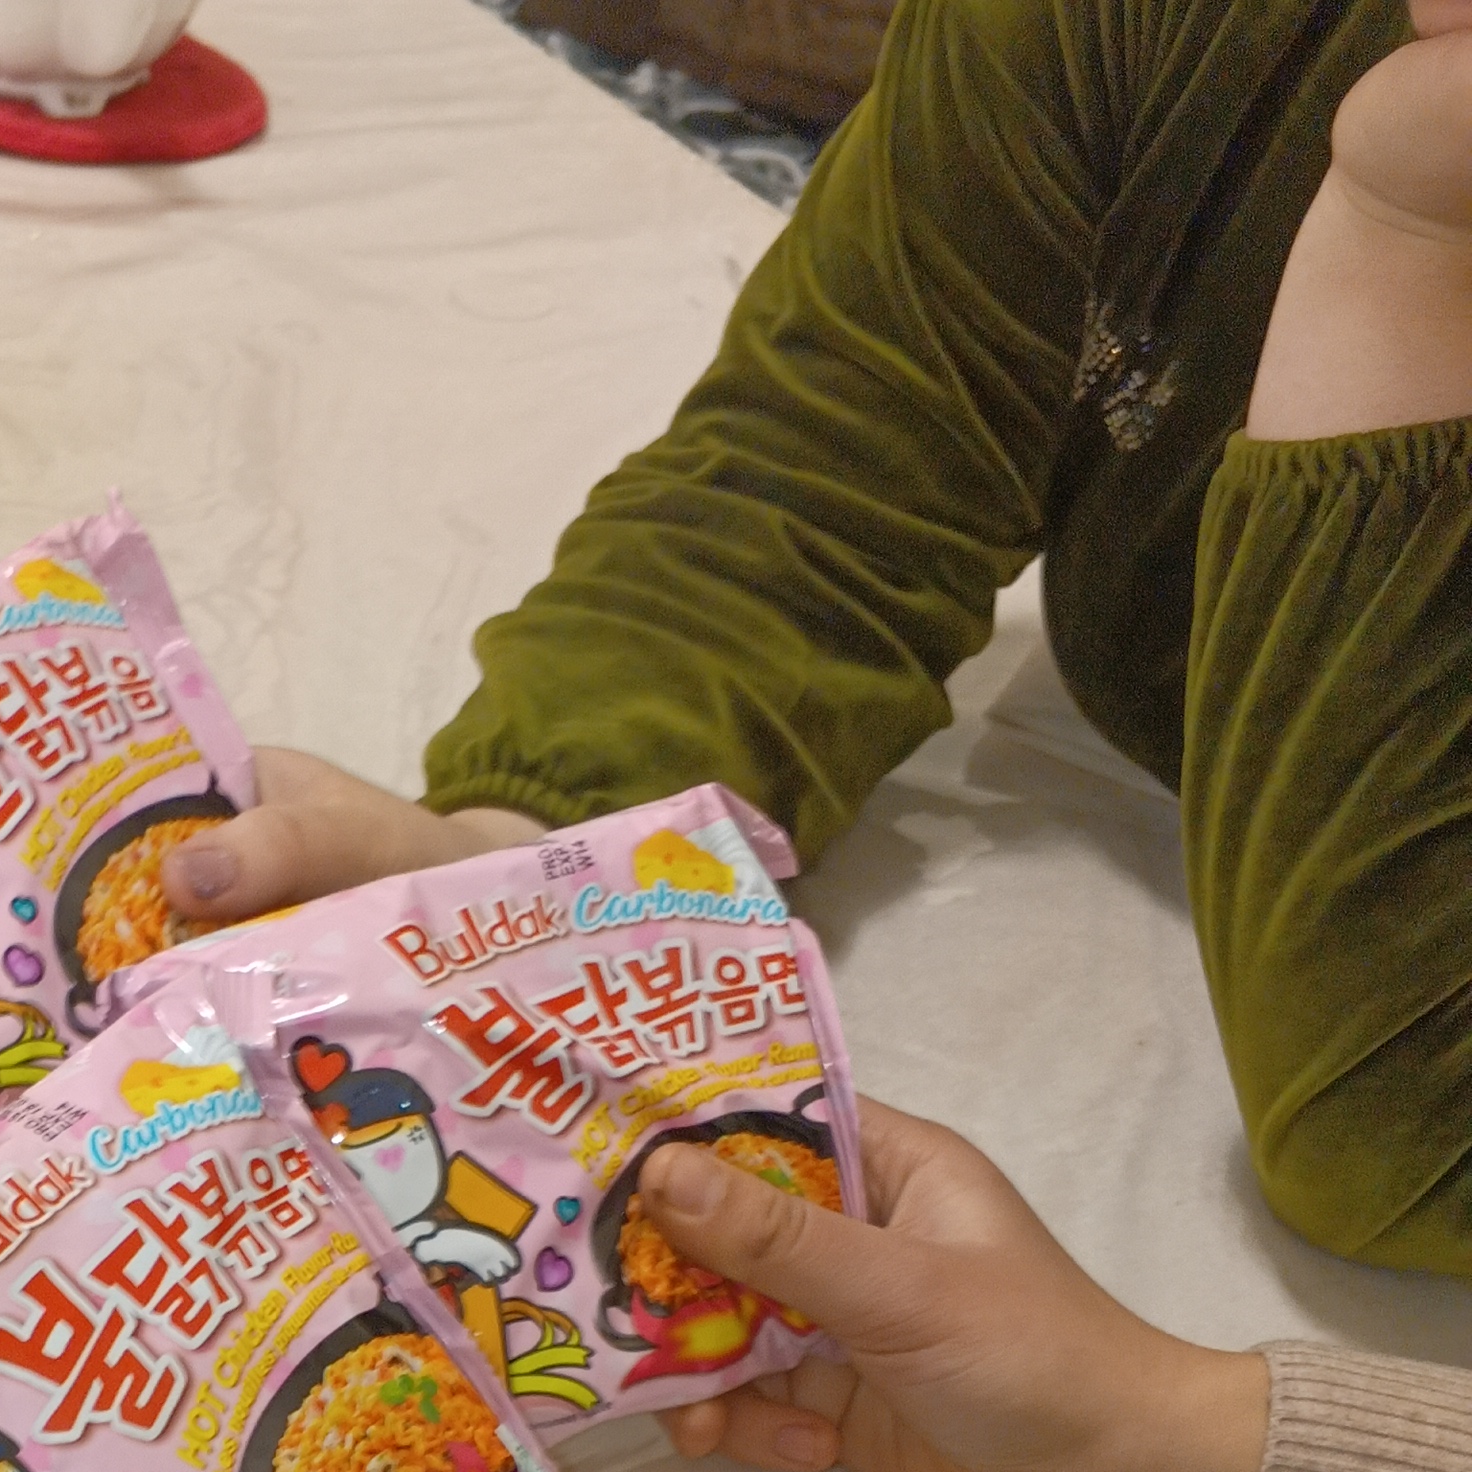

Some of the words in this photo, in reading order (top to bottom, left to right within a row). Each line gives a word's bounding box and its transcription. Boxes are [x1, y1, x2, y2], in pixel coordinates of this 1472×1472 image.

[385, 896, 561, 985] Buldak
[574, 882, 788, 931] Carbonara
[177, 1381, 227, 1470] HOT
[213, 1288, 288, 1389] Chicken
